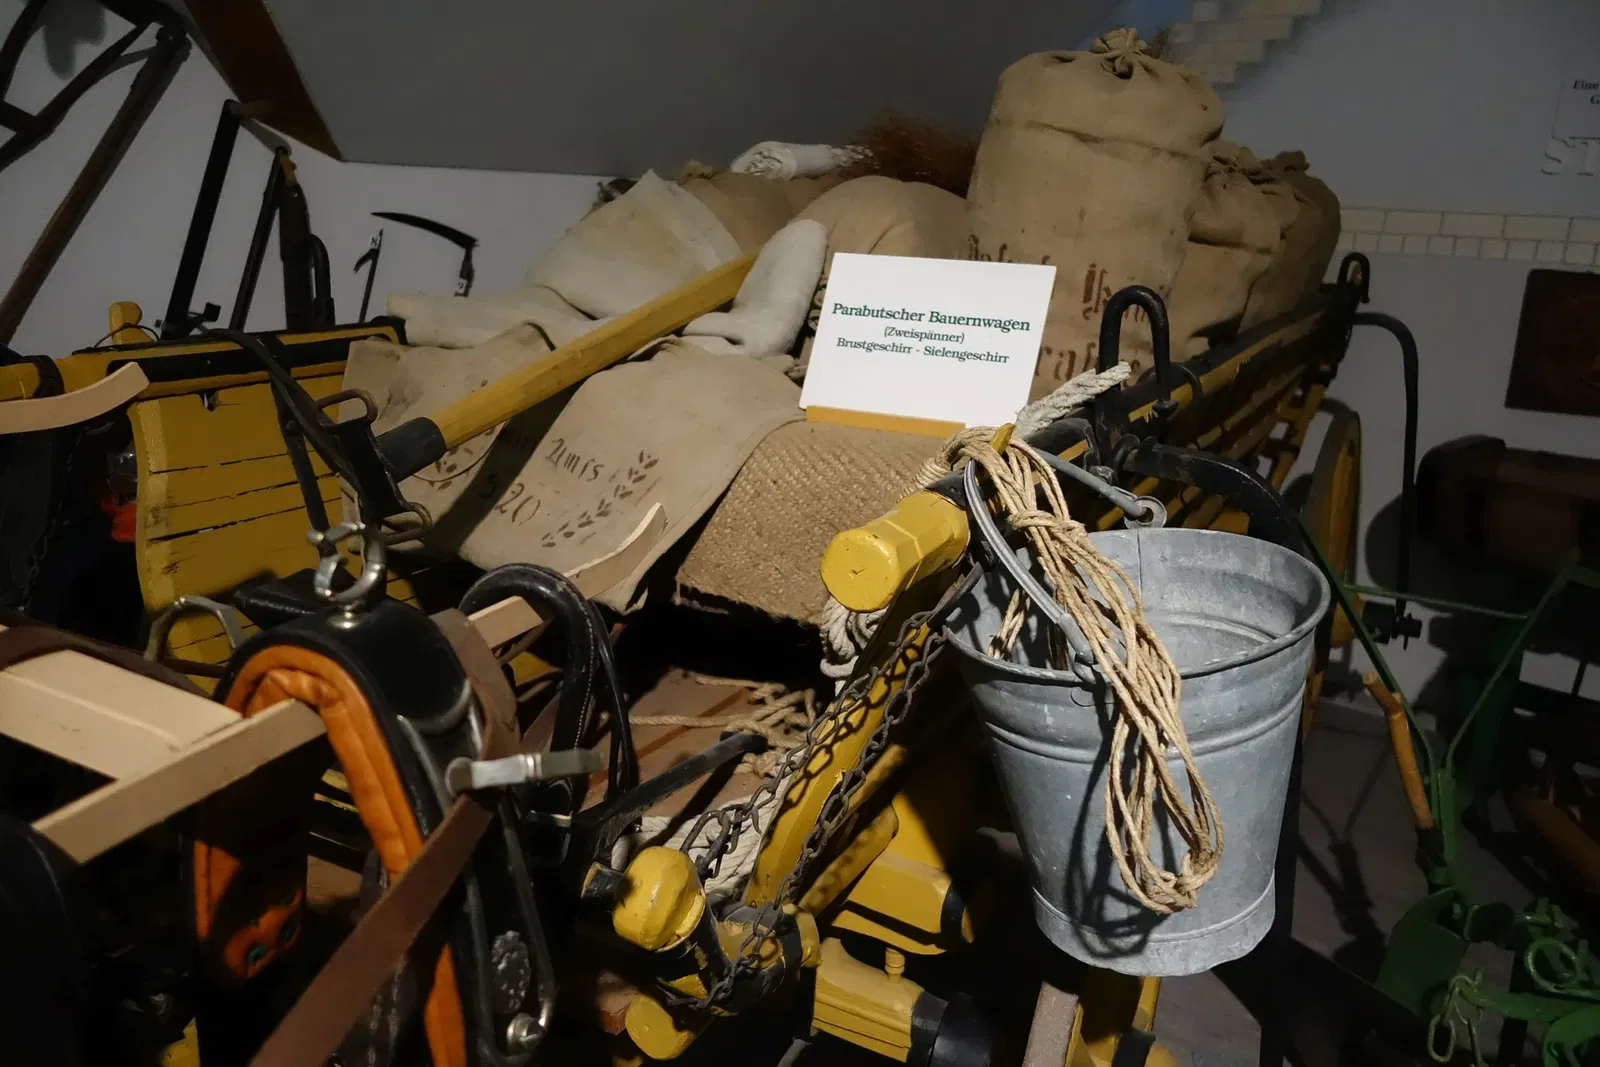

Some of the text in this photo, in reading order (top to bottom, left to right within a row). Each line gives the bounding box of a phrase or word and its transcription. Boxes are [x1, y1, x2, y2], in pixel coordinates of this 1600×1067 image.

[831, 302, 1031, 332] Parabutscher Bauernwagen
[884, 326, 965, 344] (Zweispänner)
[836, 337, 913, 354] Brustgeschirr
[923, 346, 1010, 364] Sielengeschirr
